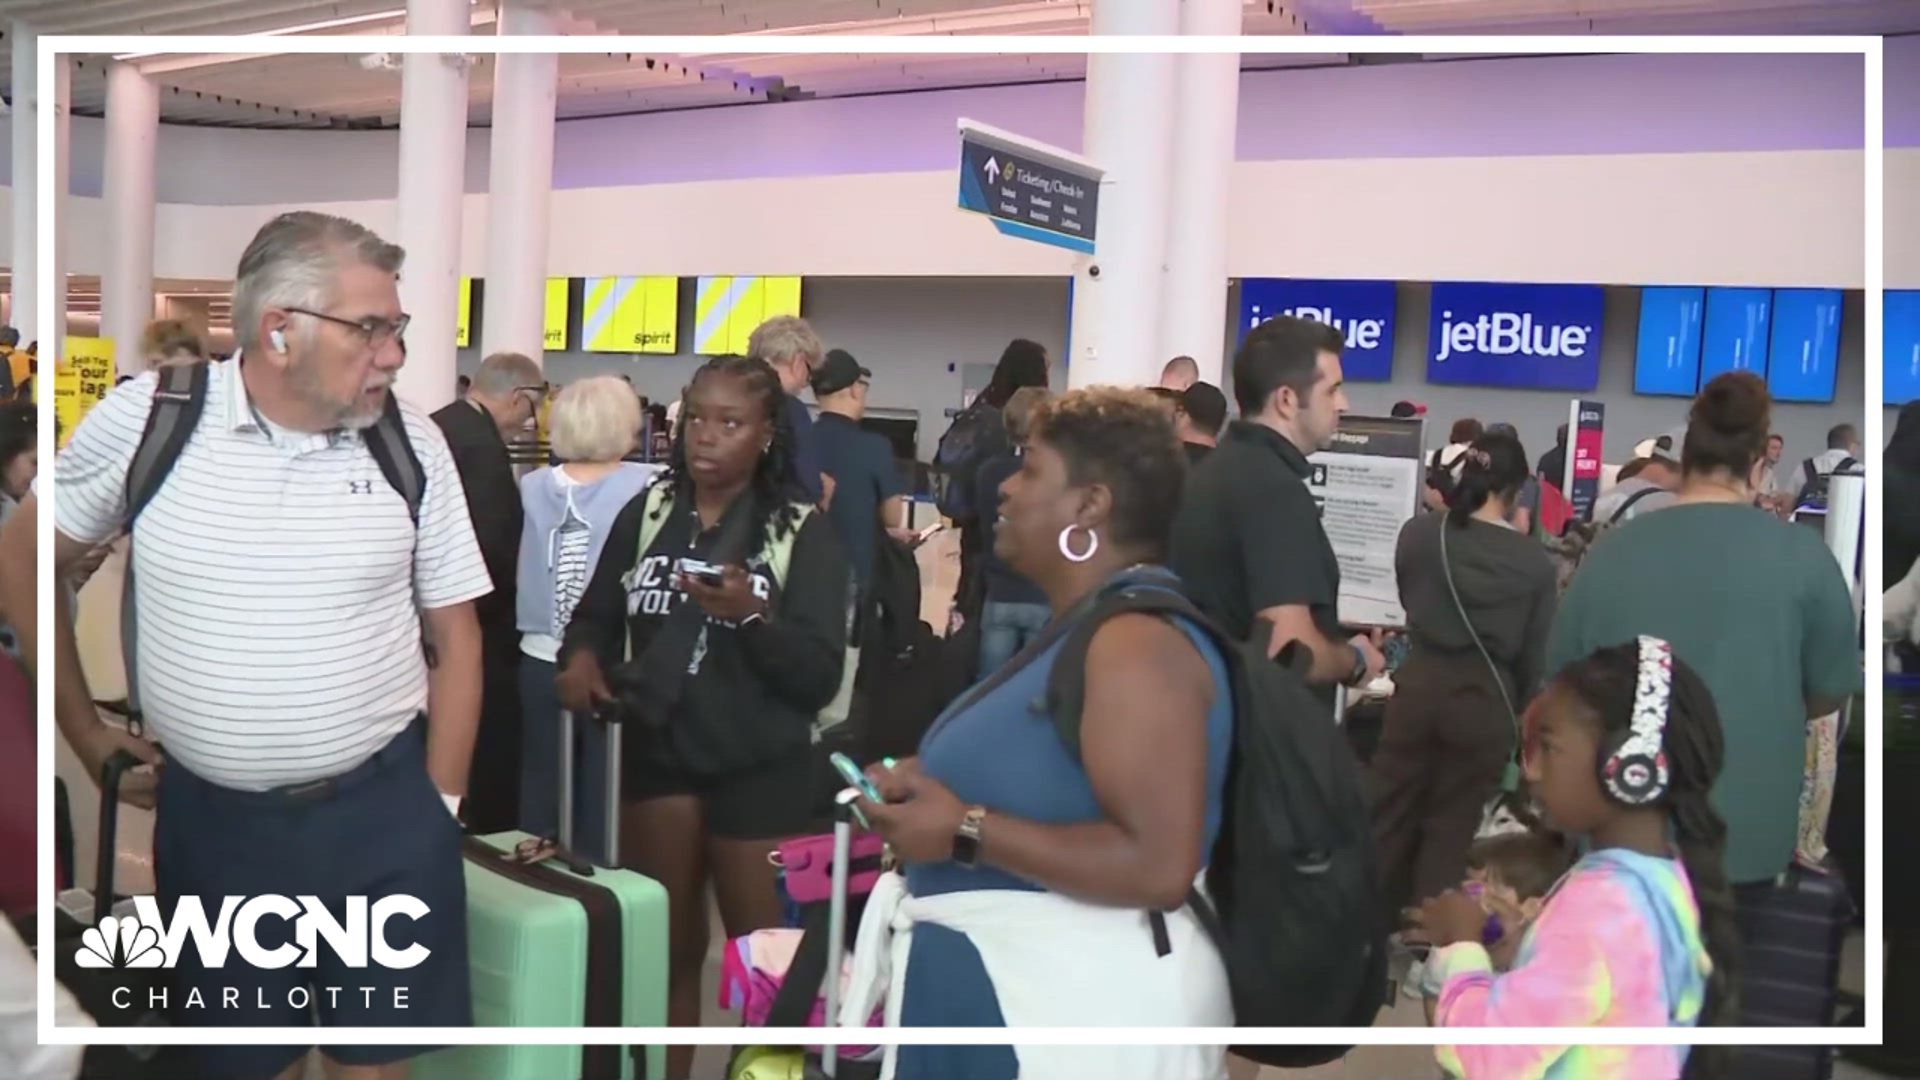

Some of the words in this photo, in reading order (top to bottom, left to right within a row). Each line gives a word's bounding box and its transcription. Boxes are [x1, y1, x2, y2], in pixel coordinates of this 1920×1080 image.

[634, 331, 671, 347] spirit
[1436, 311, 1586, 361] jetBlue
[80, 368, 108, 378] our
